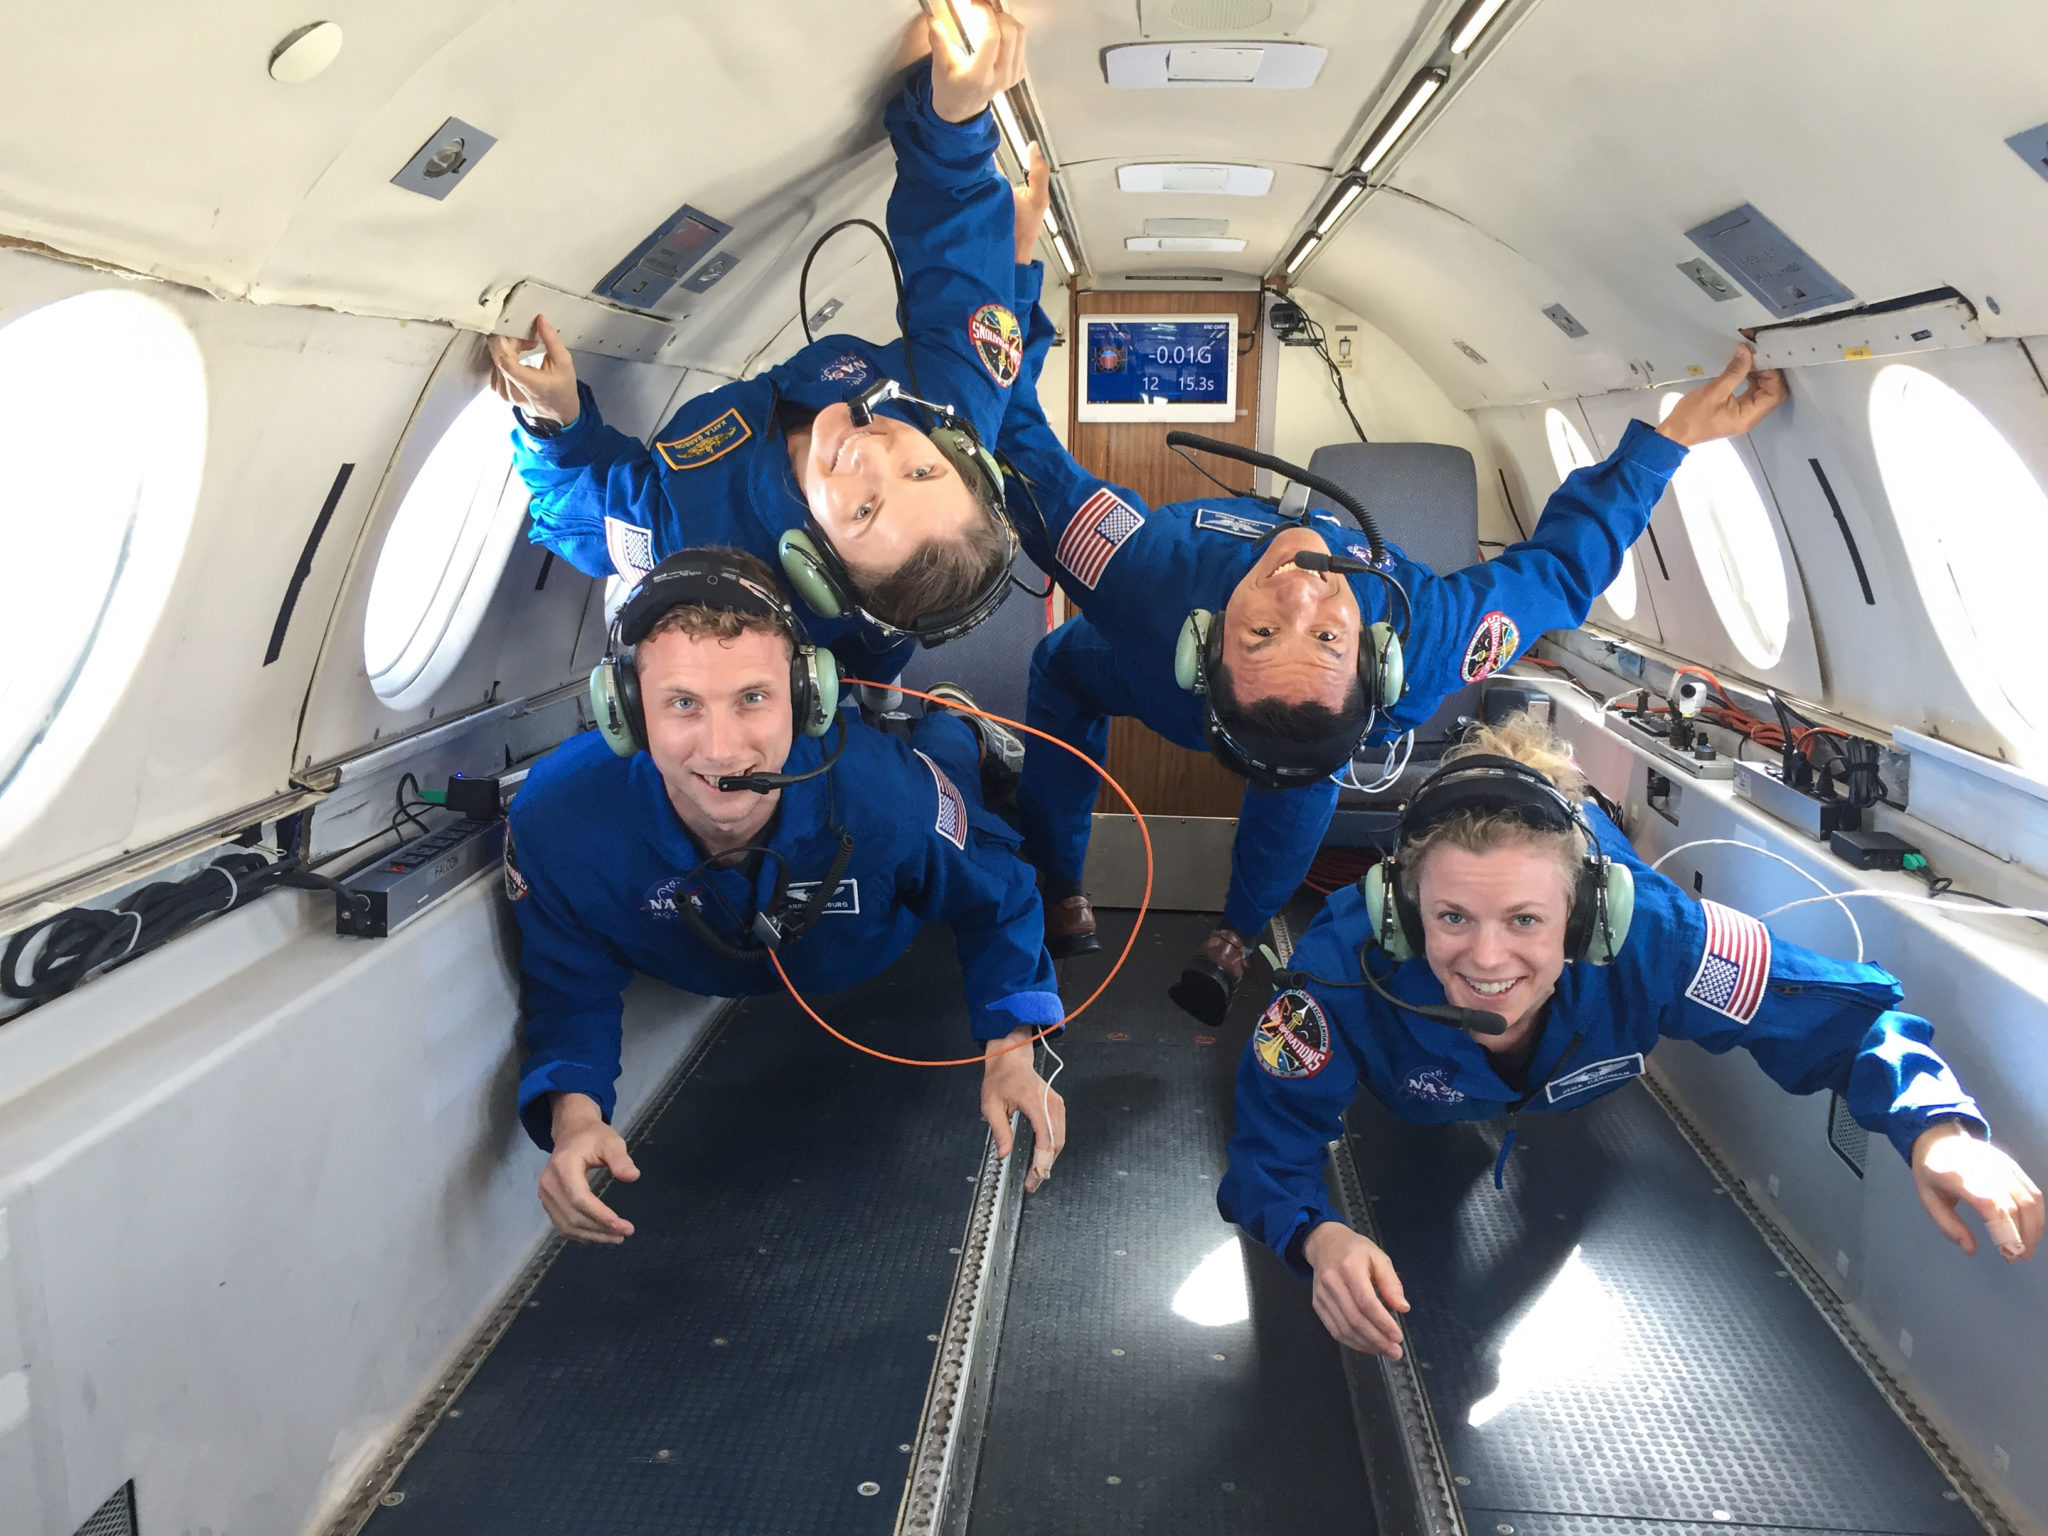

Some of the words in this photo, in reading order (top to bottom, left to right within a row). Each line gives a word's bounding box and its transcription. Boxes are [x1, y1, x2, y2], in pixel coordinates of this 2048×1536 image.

[1148, 346, 1212, 364] -0.01G
[1142, 377, 1159, 391] 12
[1178, 377, 1215, 391] 15.3s
[704, 420, 727, 436] KAYLA
[674, 434, 704, 450] BARRON
[435, 856, 459, 879] FALCON
[649, 895, 704, 911] NAA
[1279, 1022, 1325, 1072] OPERATIONS
[1562, 1083, 1584, 1094] JENA
[1587, 1070, 1631, 1086] CARDMAN
